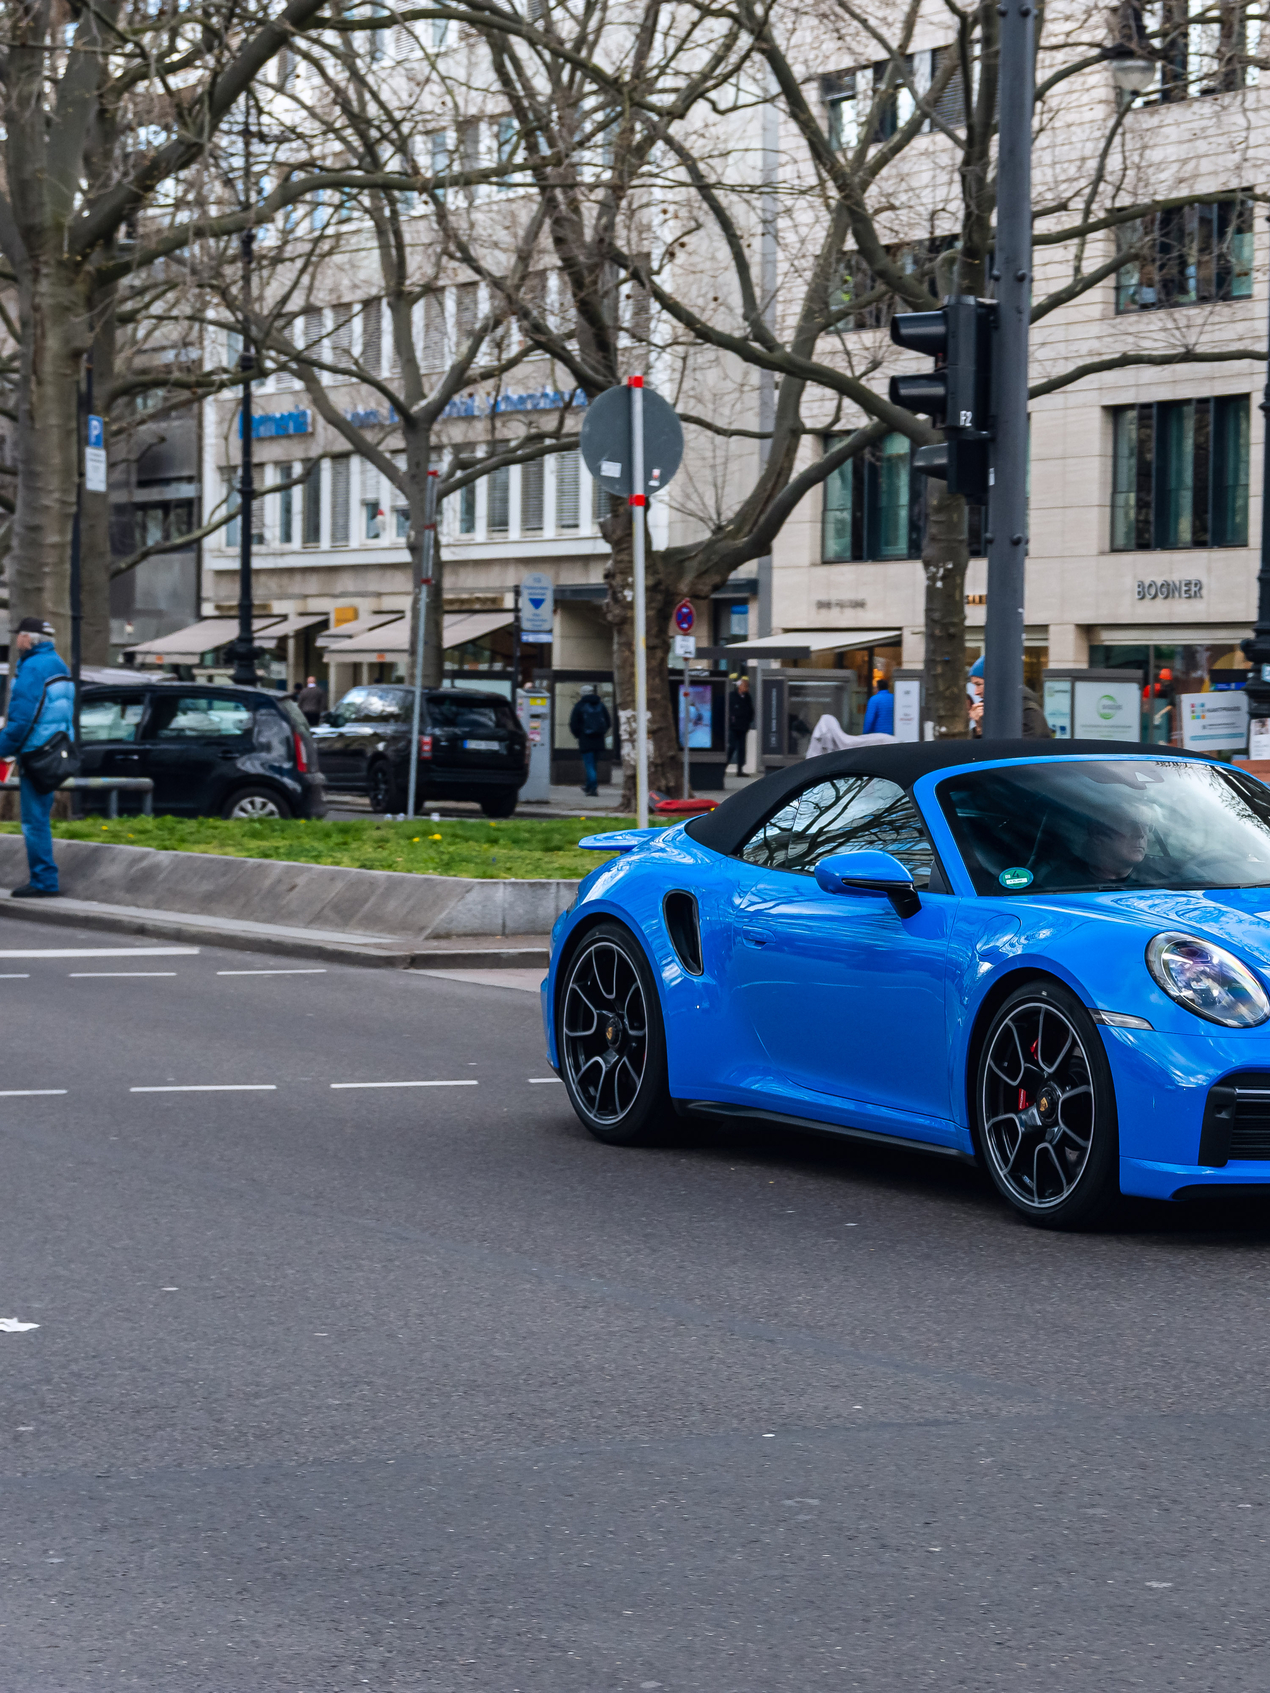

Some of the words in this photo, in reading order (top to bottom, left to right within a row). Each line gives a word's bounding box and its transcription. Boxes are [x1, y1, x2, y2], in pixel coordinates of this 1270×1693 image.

[960, 410, 972, 427] F2
[90, 419, 101, 443] P
[1136, 579, 1203, 600] BOGNER
[1012, 870, 1020, 879] 4
